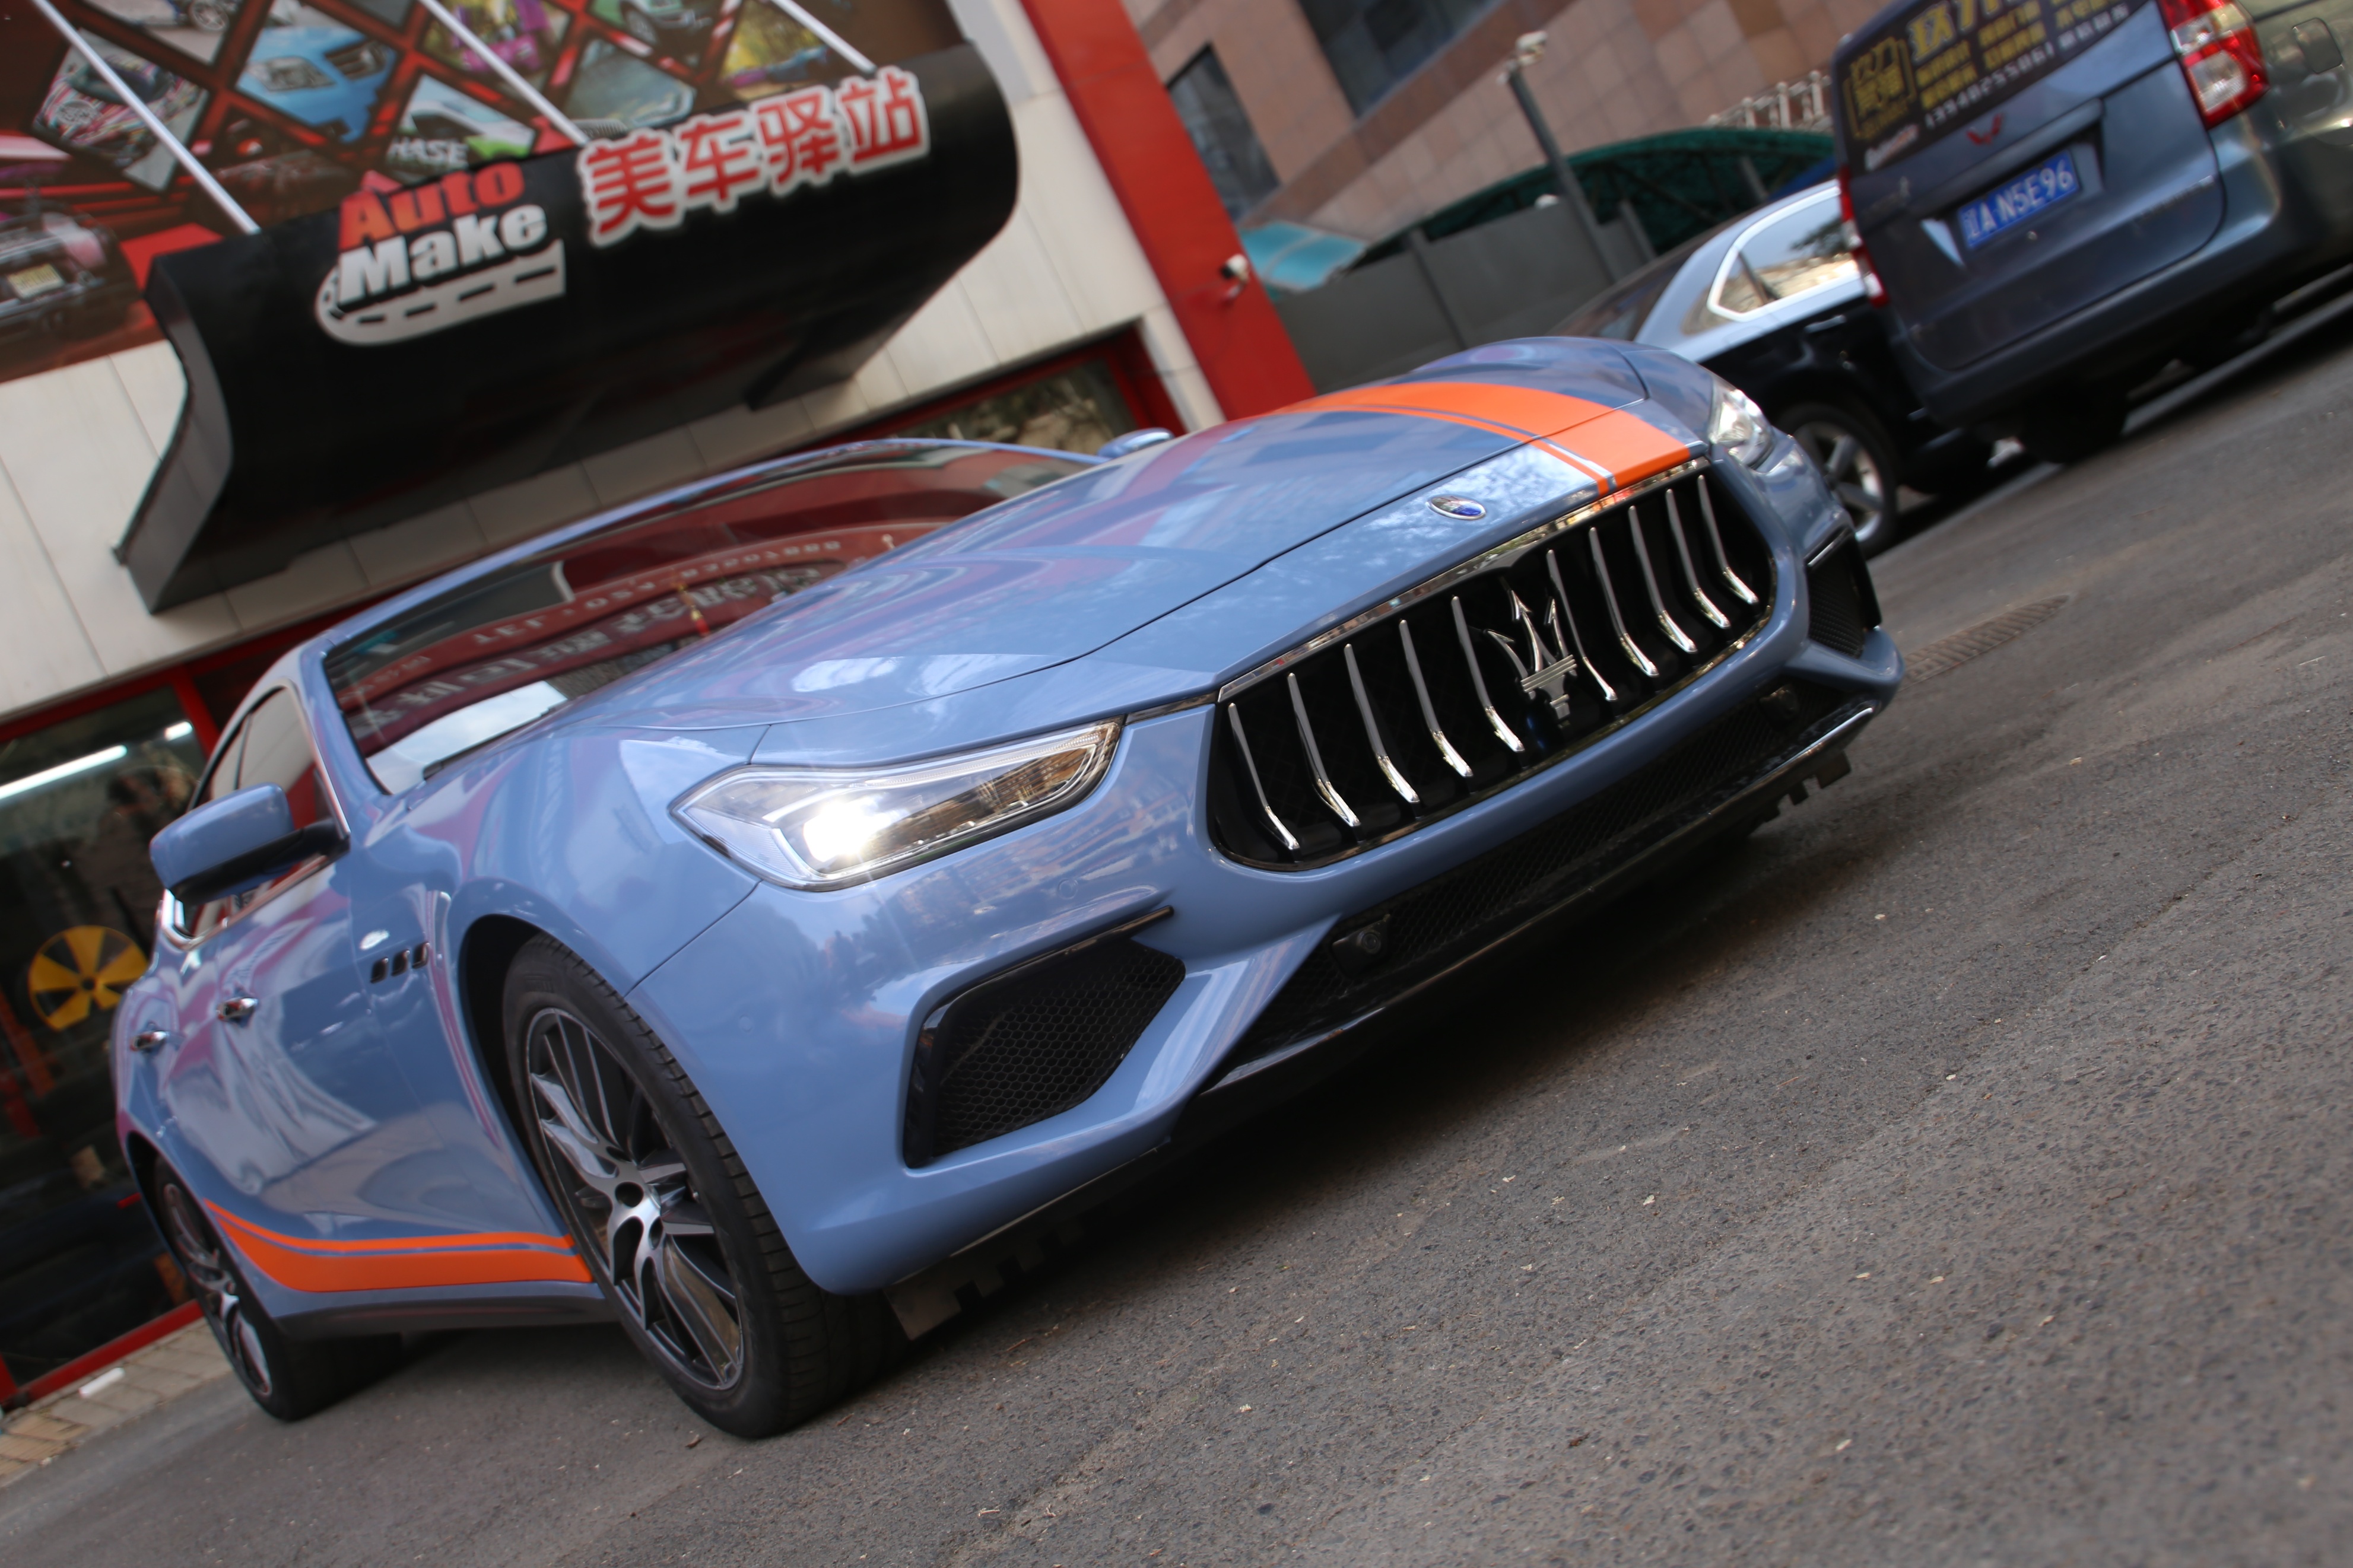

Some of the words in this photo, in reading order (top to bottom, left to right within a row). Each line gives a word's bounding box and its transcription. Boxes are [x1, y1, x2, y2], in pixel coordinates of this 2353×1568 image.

[338, 161, 525, 251] Auto
[580, 69, 928, 244] 美车驿站
[338, 204, 548, 304] Make
